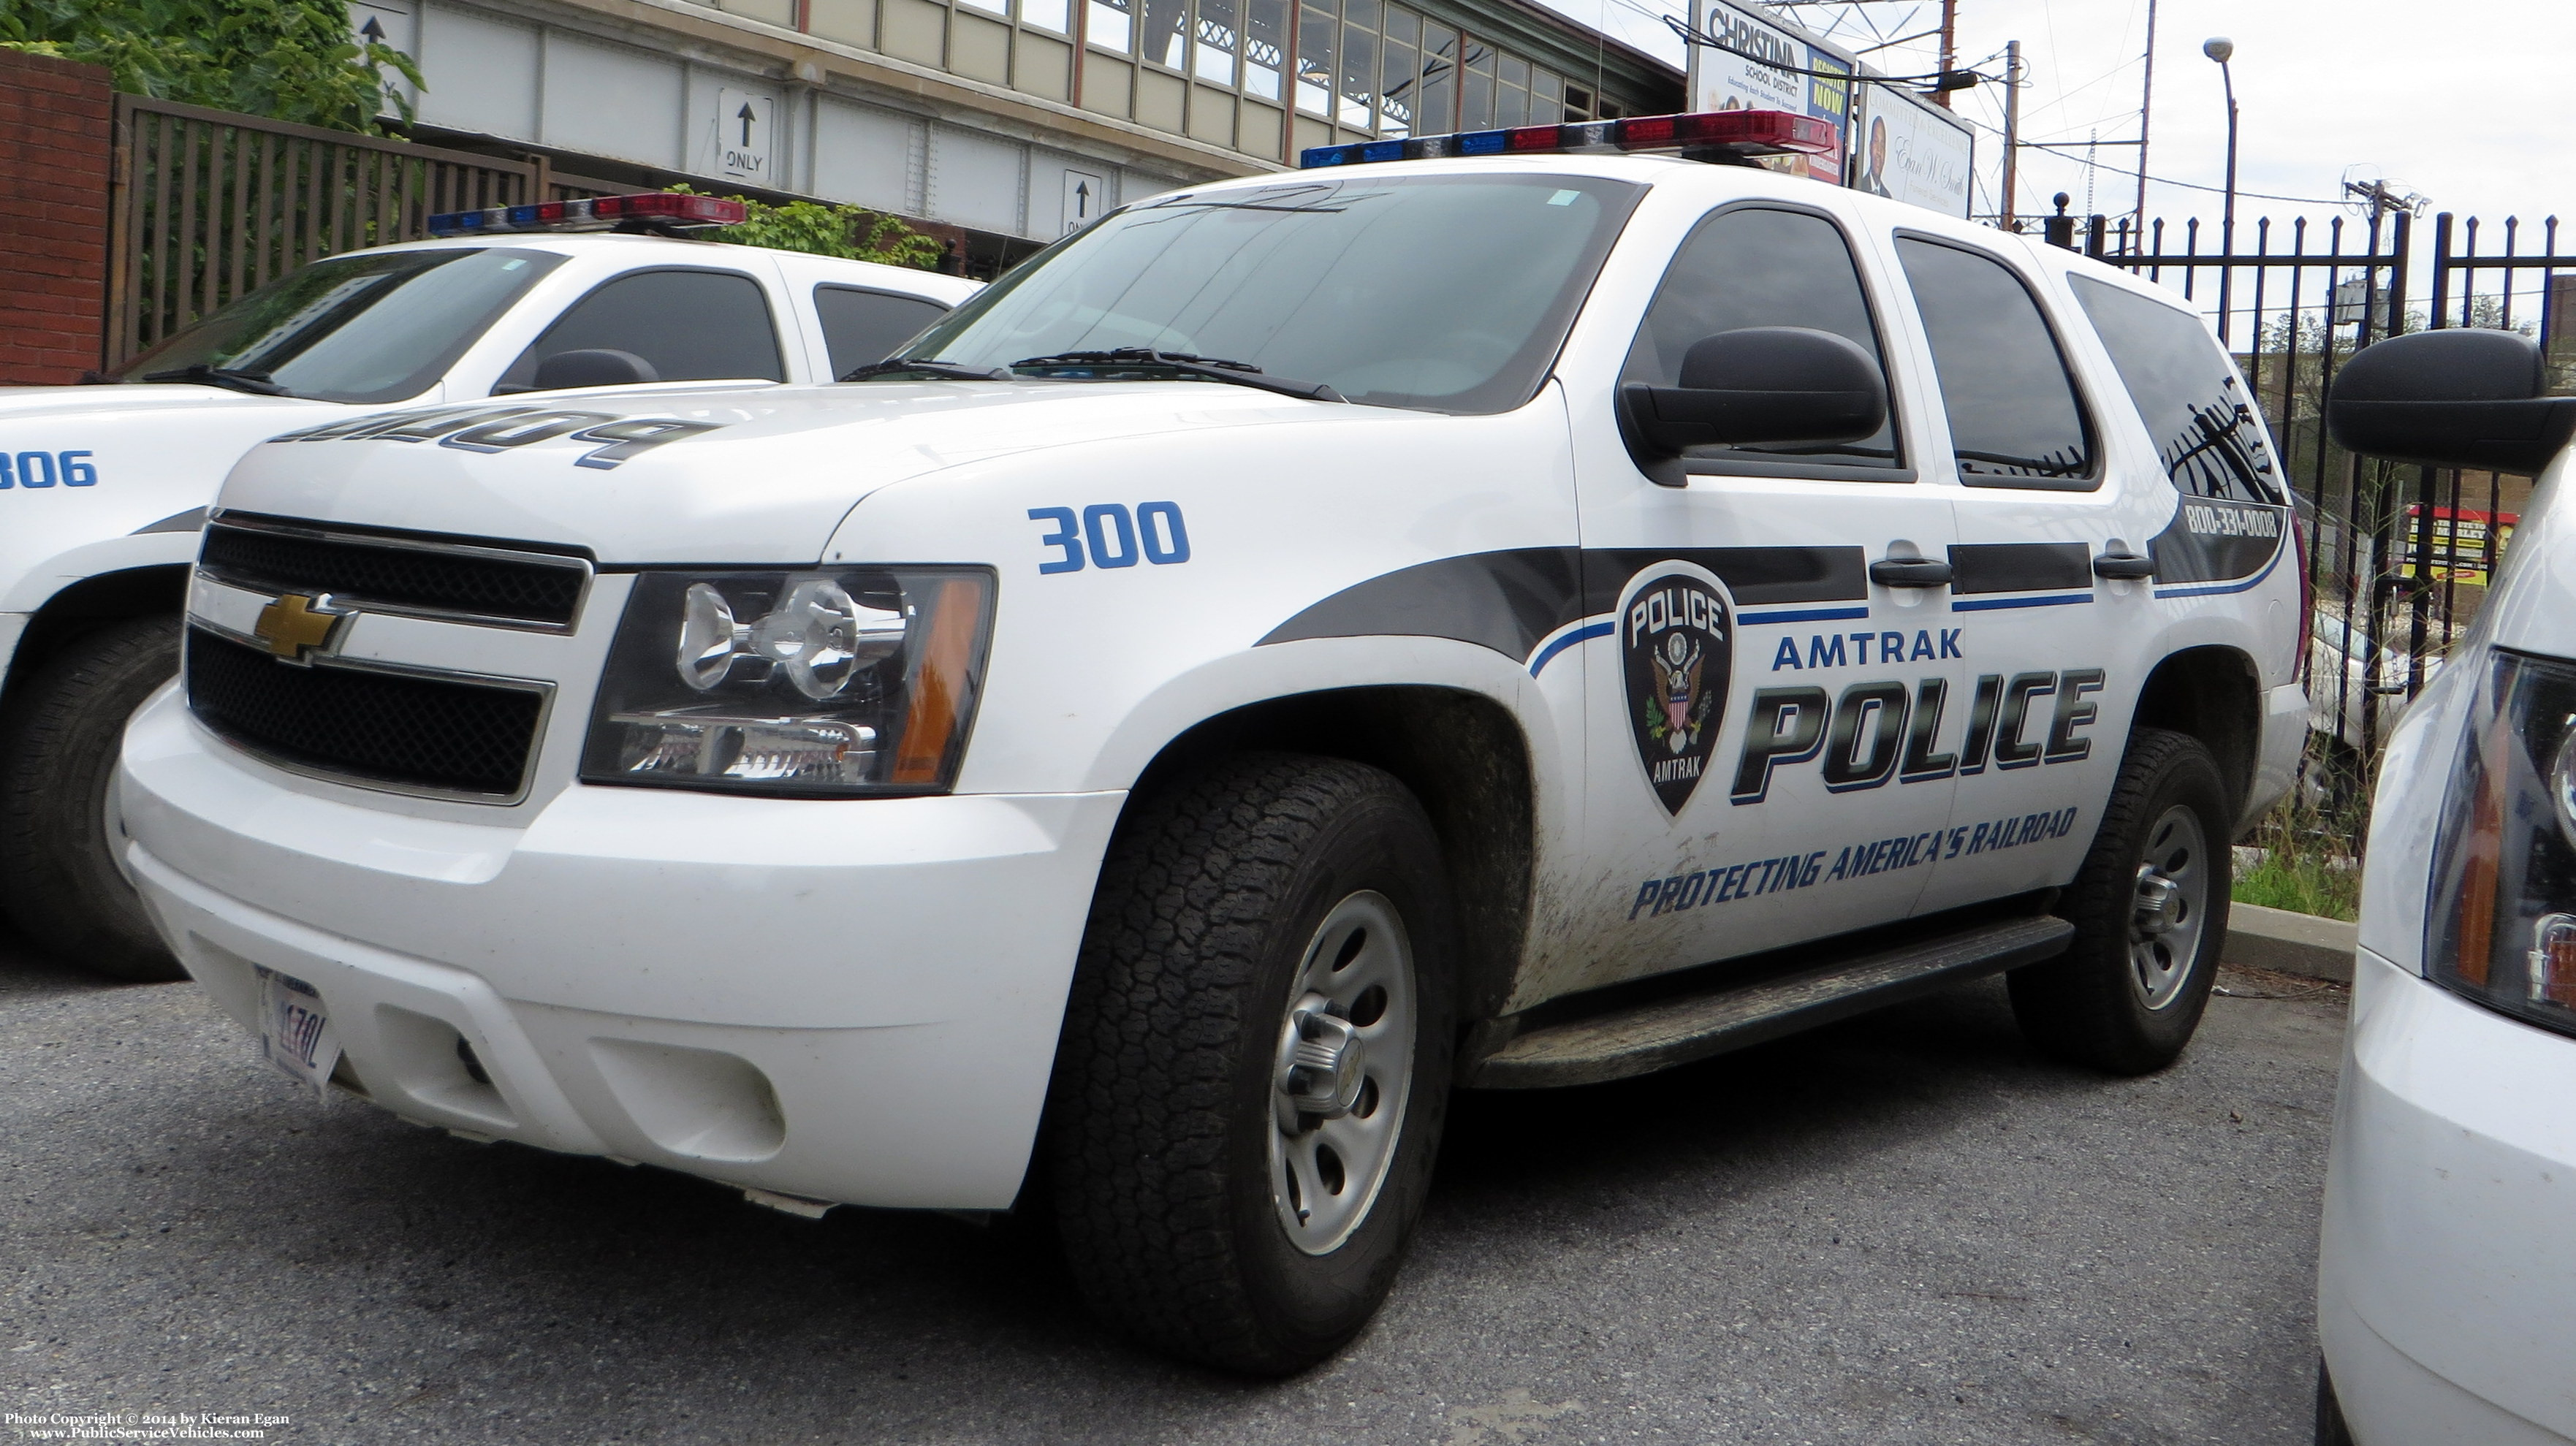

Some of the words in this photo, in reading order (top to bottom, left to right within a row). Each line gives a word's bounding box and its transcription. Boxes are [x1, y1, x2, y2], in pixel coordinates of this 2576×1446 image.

[1709, 8, 1799, 83] CHRISTINA
[1728, 75, 1749, 94] Educating
[1745, 64, 1771, 88] SCHOOL
[1773, 76, 1798, 98] DISTRICT
[1812, 56, 1846, 94] REGISTER
[1813, 82, 1843, 115] NOW
[726, 151, 763, 172] ONLY
[1895, 135, 1923, 176] Evan
[1940, 161, 1965, 197] Smith
[1027, 501, 1191, 575] 300
[2184, 505, 2278, 538] 800-331-0008
[1631, 587, 1724, 649] POLICE
[1771, 628, 1964, 671] AMTRAK
[1729, 667, 2107, 807] POLICE
[1654, 755, 1701, 785] AMTRAK
[1627, 850, 1828, 921] PROTECTING
[1825, 824, 1966, 883] AMERICA'S
[1967, 806, 2078, 855] RAILROAD
